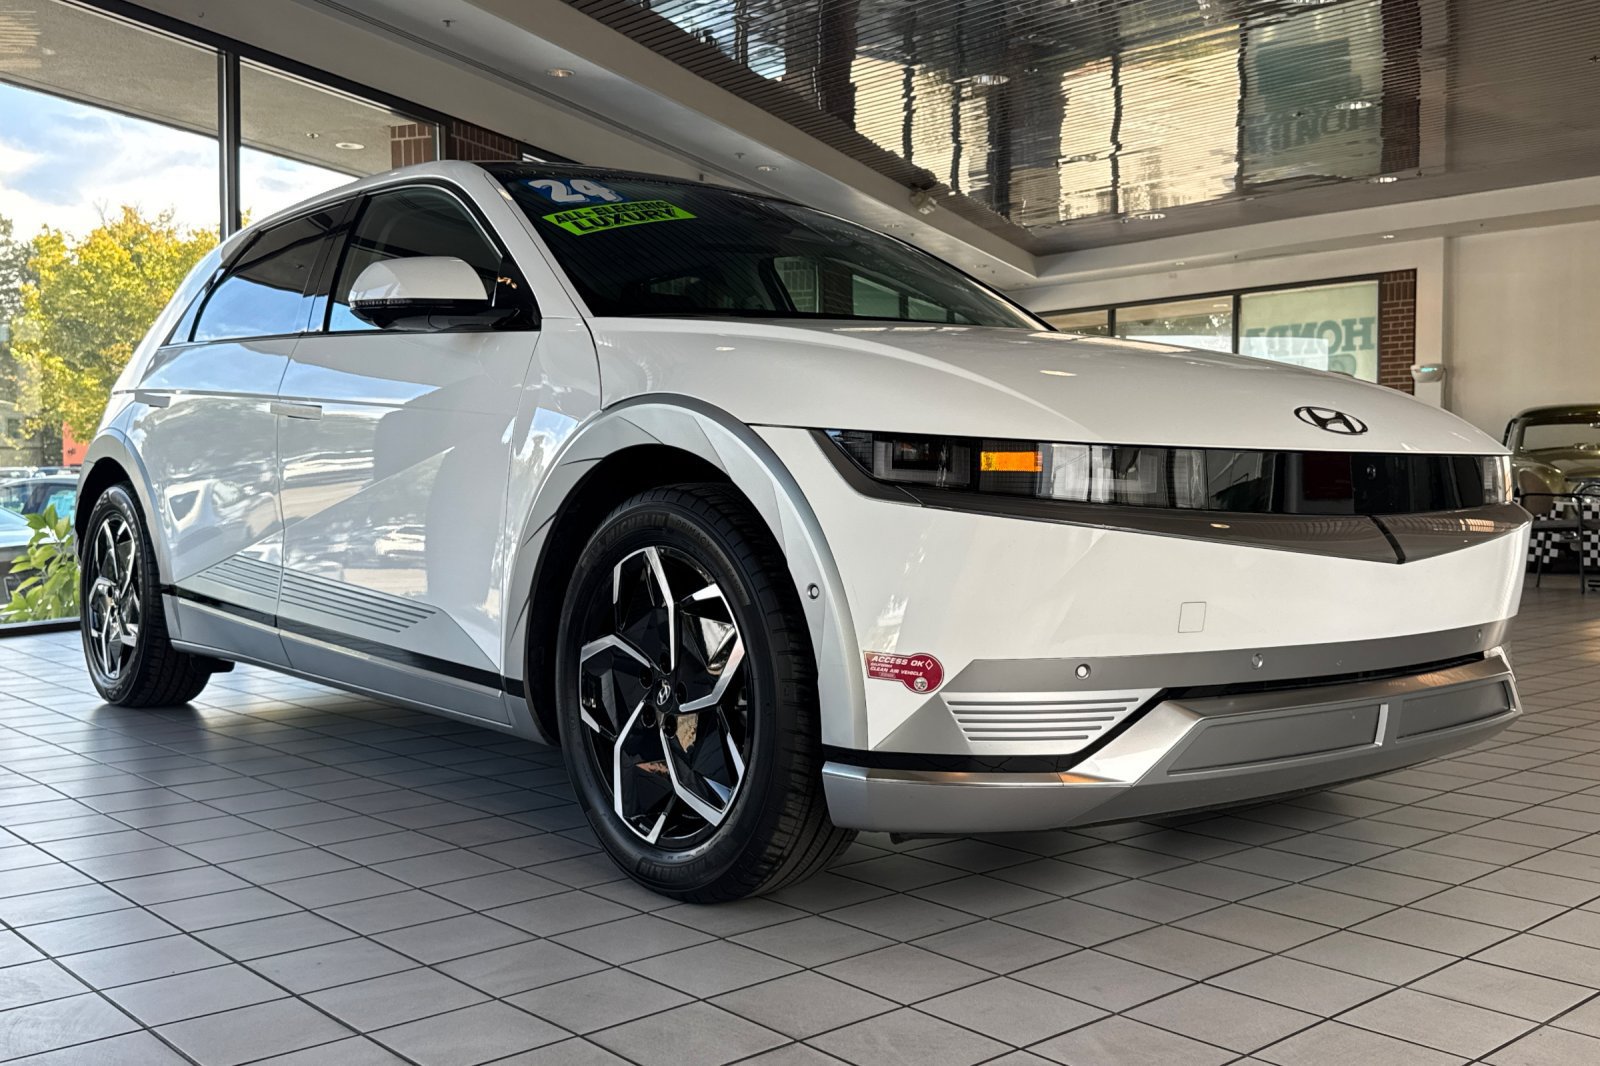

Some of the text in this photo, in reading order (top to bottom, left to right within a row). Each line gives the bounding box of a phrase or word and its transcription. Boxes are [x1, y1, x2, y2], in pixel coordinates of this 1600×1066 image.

[528, 179, 622, 202] 24
[553, 201, 671, 224] ALL-ELECTRIC
[572, 209, 676, 231] LUXURY
[871, 656, 908, 666] ACCESS
